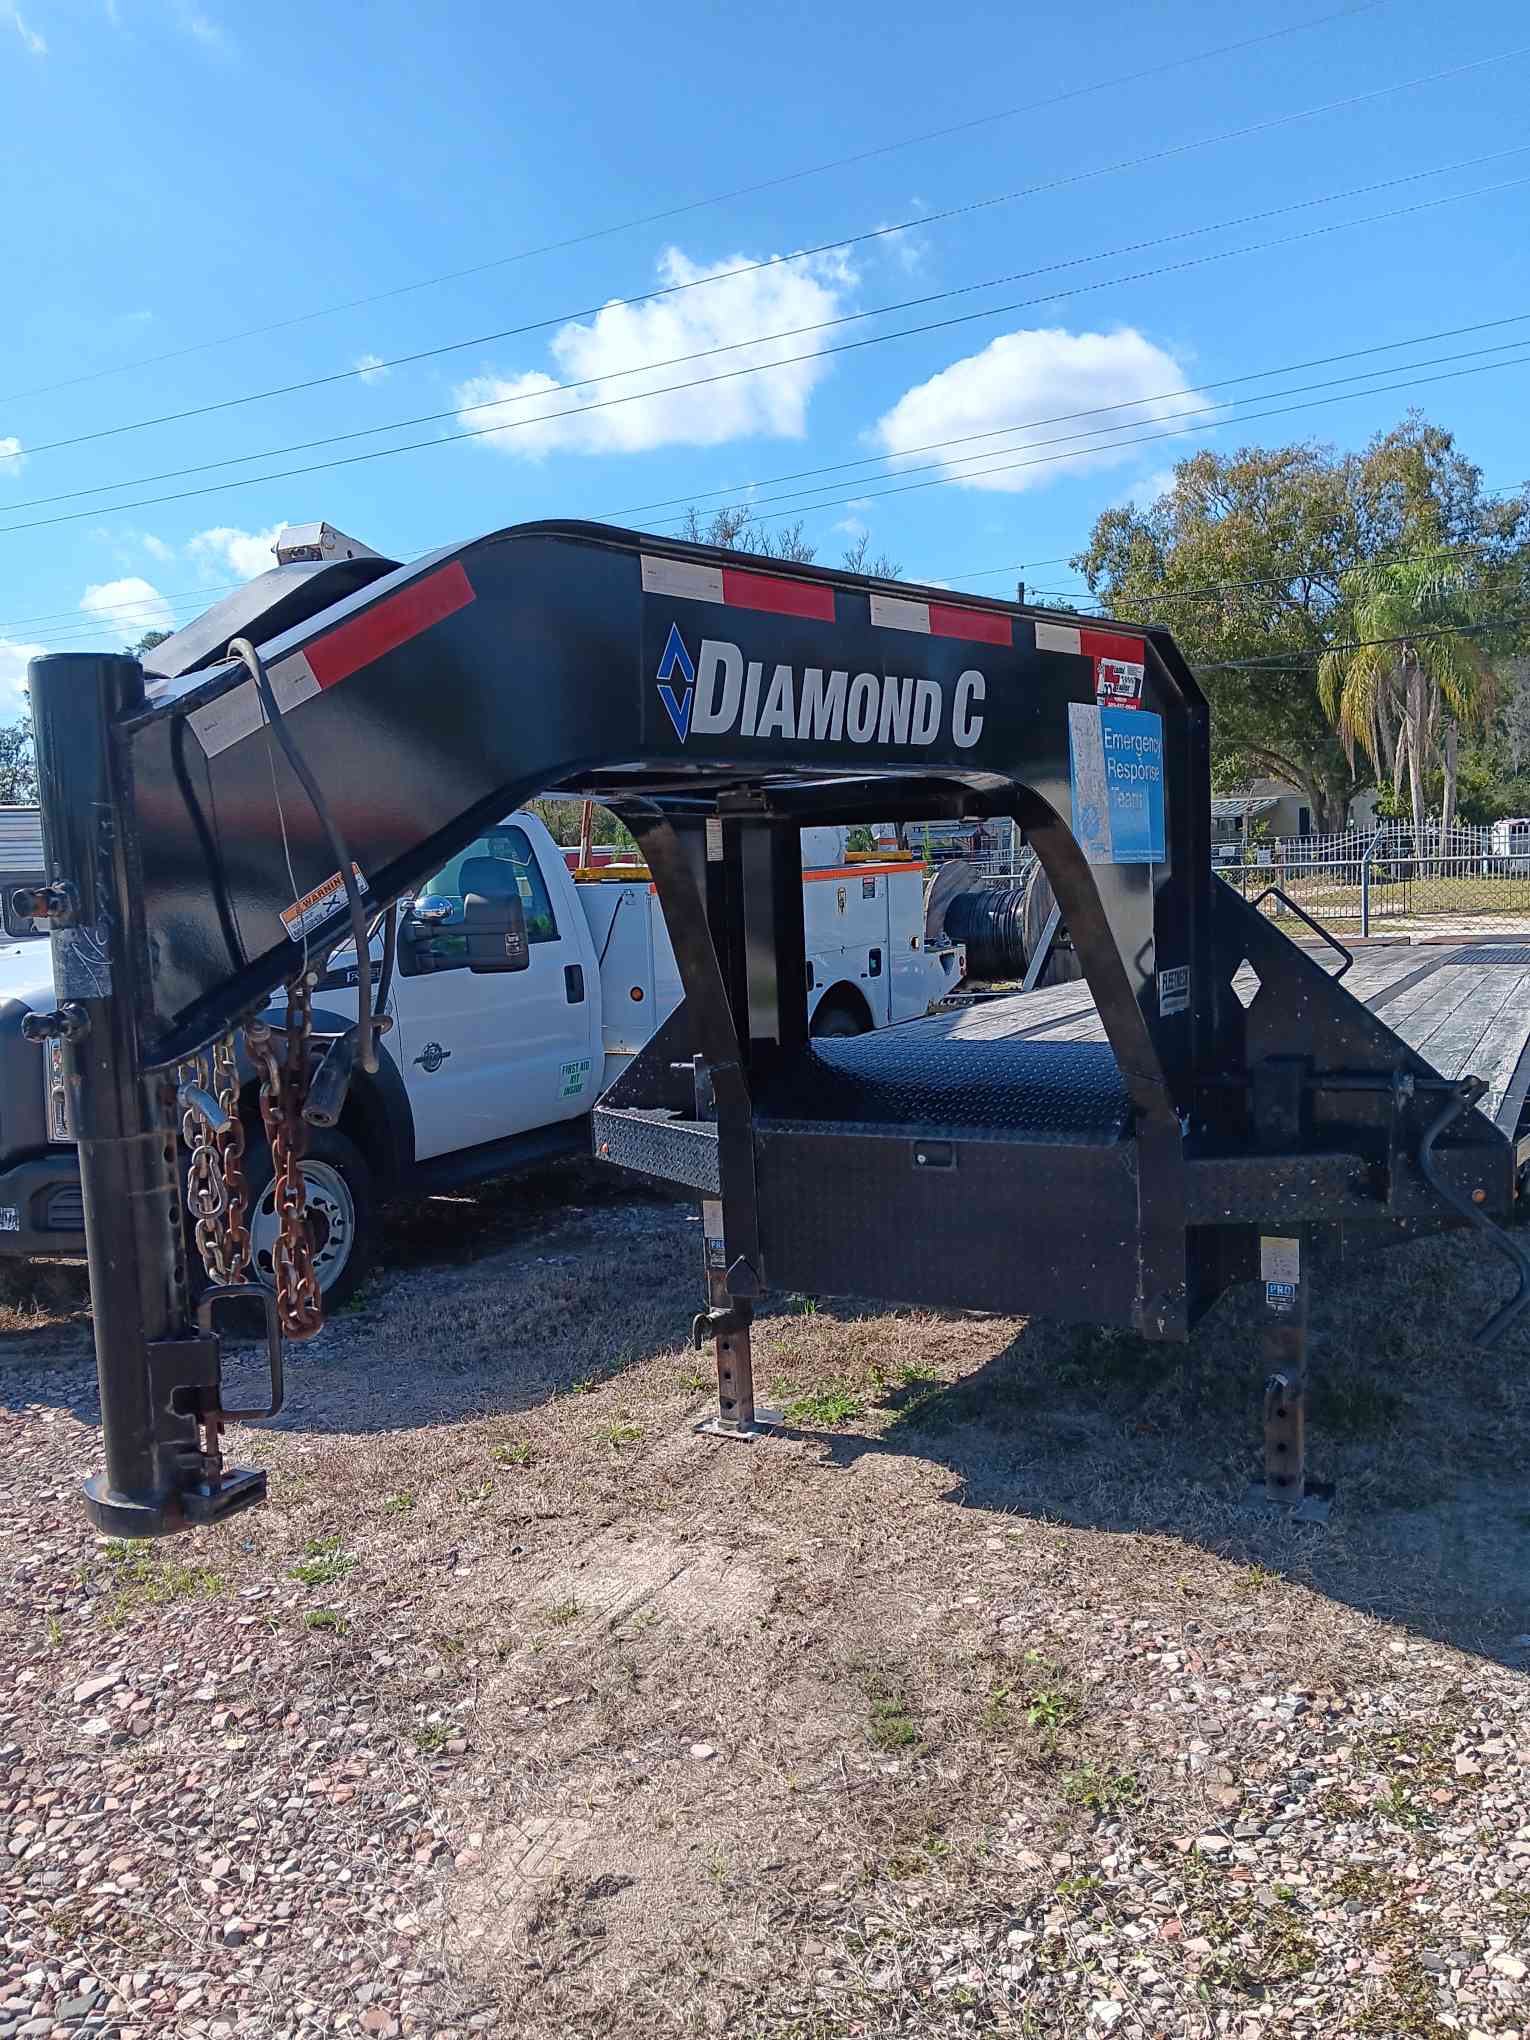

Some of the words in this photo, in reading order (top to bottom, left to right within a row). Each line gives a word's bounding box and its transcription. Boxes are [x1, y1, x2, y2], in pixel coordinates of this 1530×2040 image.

[952, 670, 986, 748] C
[1104, 727, 1161, 758] Emergency
[1107, 757, 1159, 784] Response
[1111, 785, 1144, 808] Team
[302, 876, 344, 908] WARNIN
[562, 1062, 579, 1076] FIRST
[580, 1060, 590, 1071] AID
